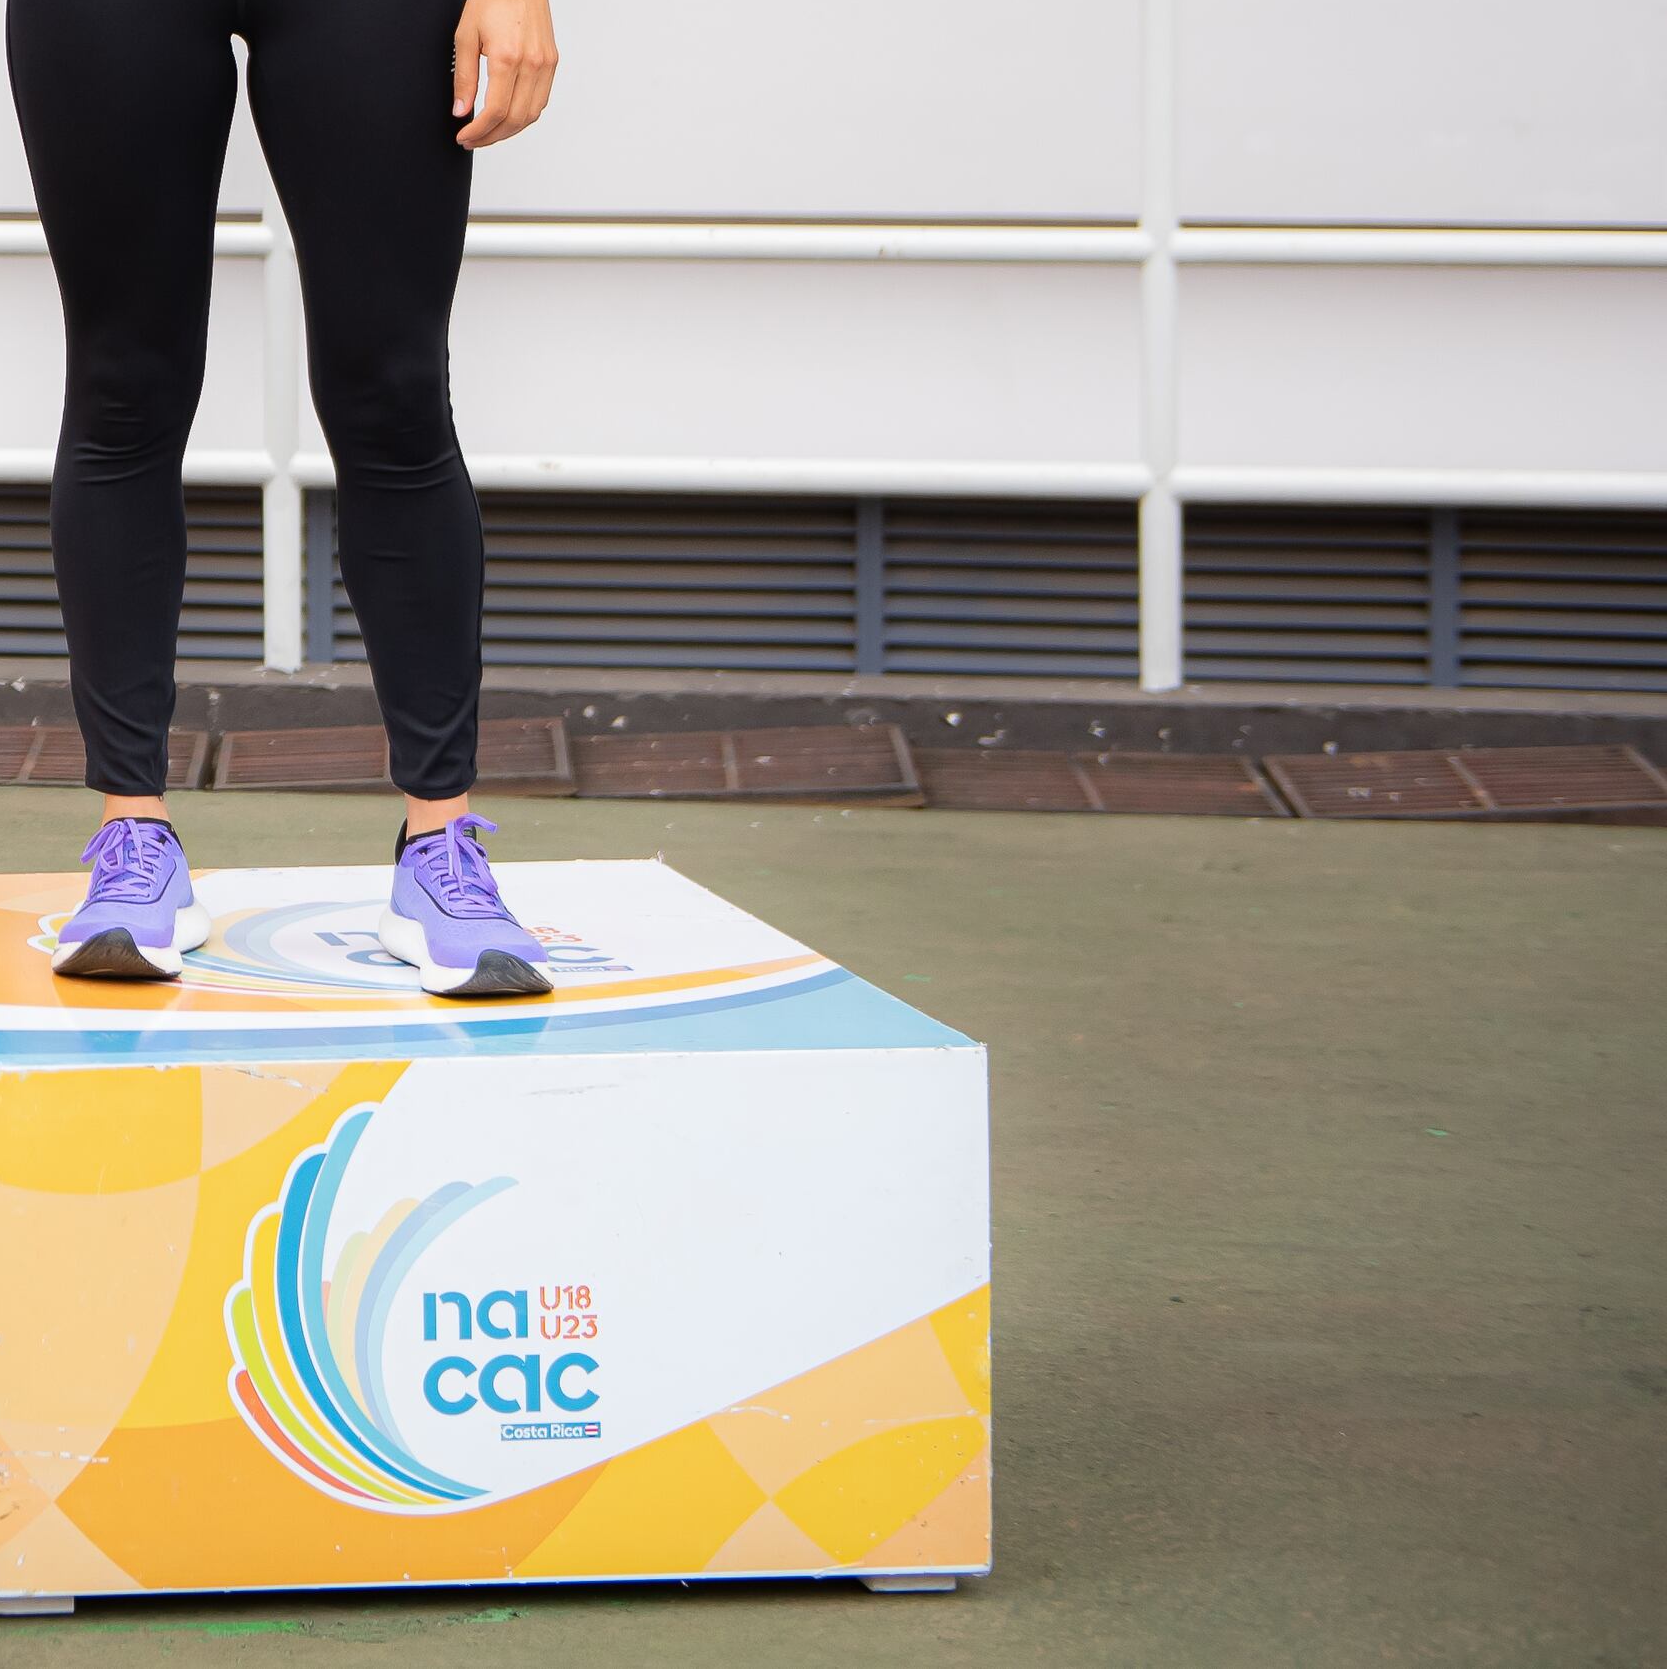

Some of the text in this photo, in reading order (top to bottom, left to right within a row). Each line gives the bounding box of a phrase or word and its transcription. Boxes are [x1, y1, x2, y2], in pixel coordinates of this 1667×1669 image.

[540, 1285, 592, 1311] U18
[423, 1290, 528, 1341] na
[540, 1314, 598, 1340] U23
[423, 1352, 601, 1416] cac
[502, 1422, 583, 1439] Costa Rica
